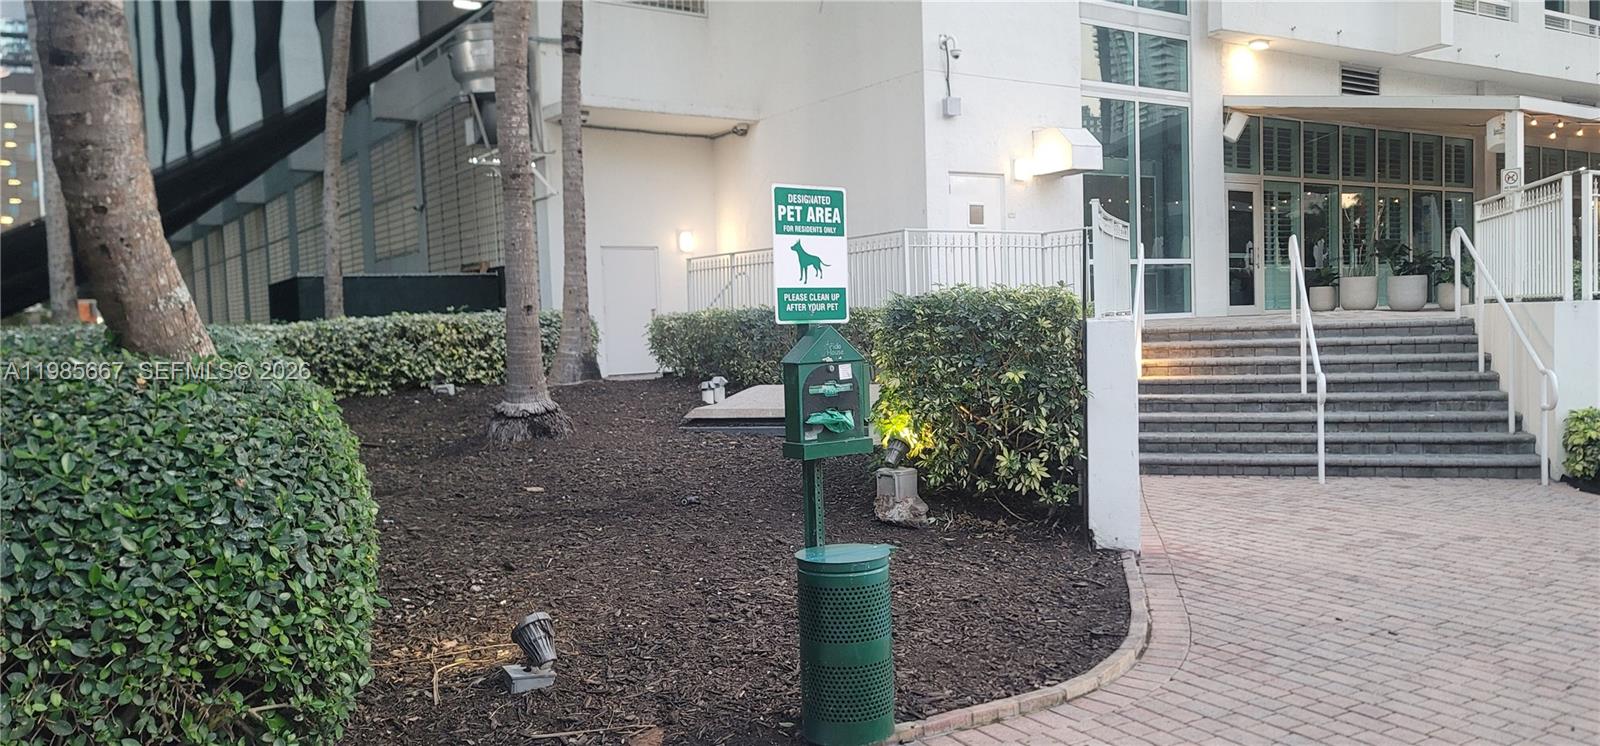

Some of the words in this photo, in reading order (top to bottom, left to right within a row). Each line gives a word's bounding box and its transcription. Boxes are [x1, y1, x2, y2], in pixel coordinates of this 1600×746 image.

[788, 194, 831, 205] DESIGNATED
[778, 205, 802, 222] PET
[807, 206, 841, 223] AREA
[795, 225, 822, 233] RESIDENTS
[784, 293, 808, 301] PLEASE
[809, 293, 830, 301] CLEAN
[831, 293, 840, 301] UP
[786, 303, 807, 311] AFTER
[807, 303, 826, 311] YOUR
[827, 303, 838, 311] PET
